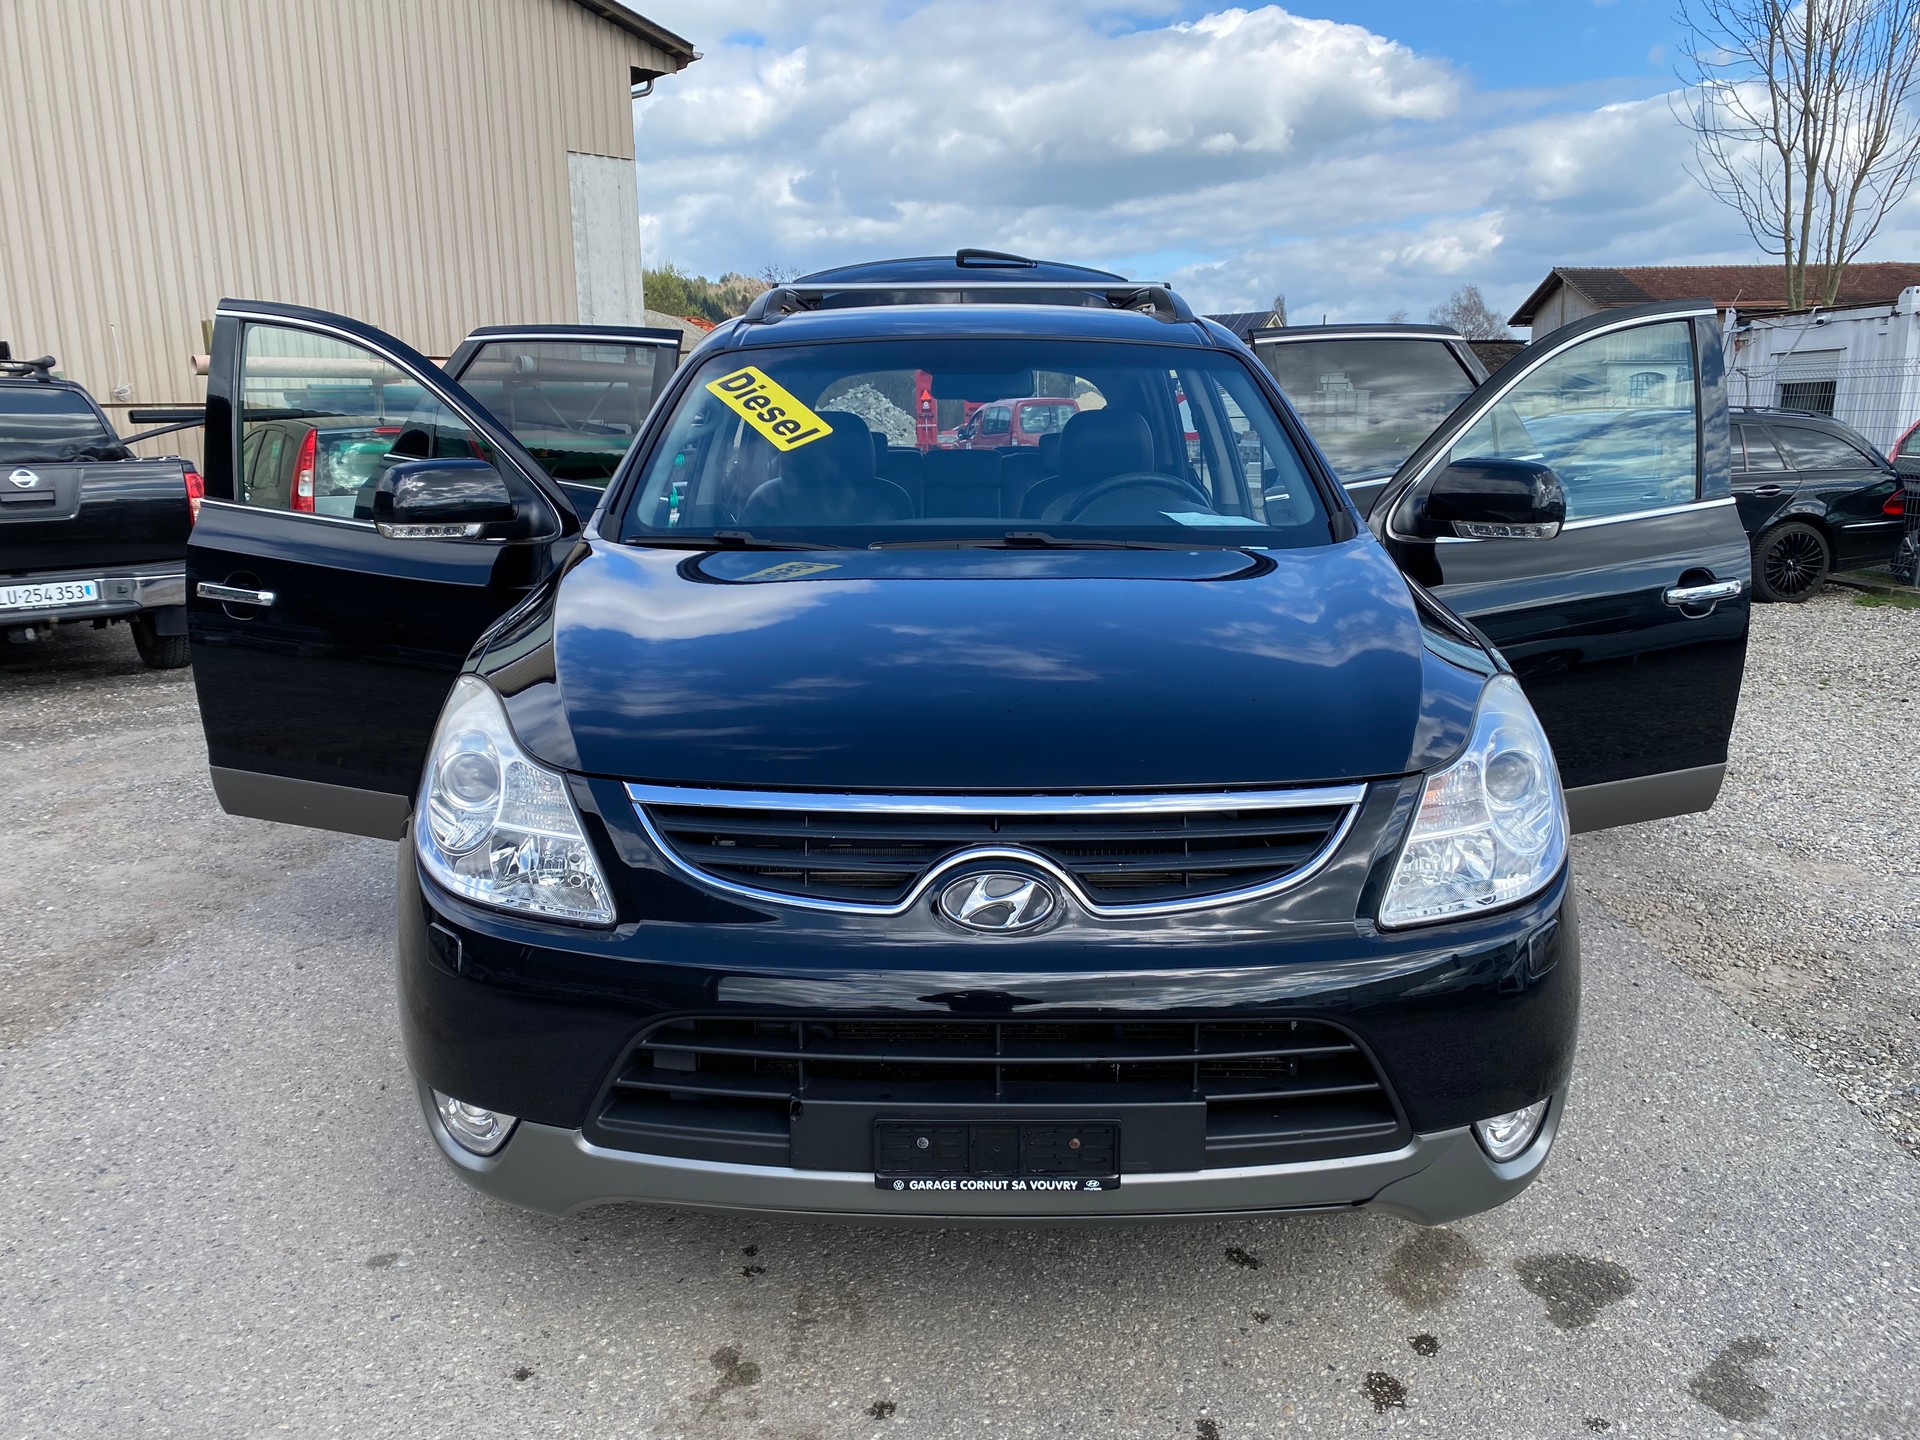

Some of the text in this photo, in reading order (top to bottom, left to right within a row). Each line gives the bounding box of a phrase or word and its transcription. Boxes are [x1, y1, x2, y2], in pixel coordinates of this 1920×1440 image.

[717, 371, 821, 445] Diesel
[909, 1180, 957, 1191] GARAGE
[960, 1180, 1009, 1191] CORNUT
[1011, 1180, 1027, 1191] SA
[1029, 1180, 1078, 1191] VOUVRY
